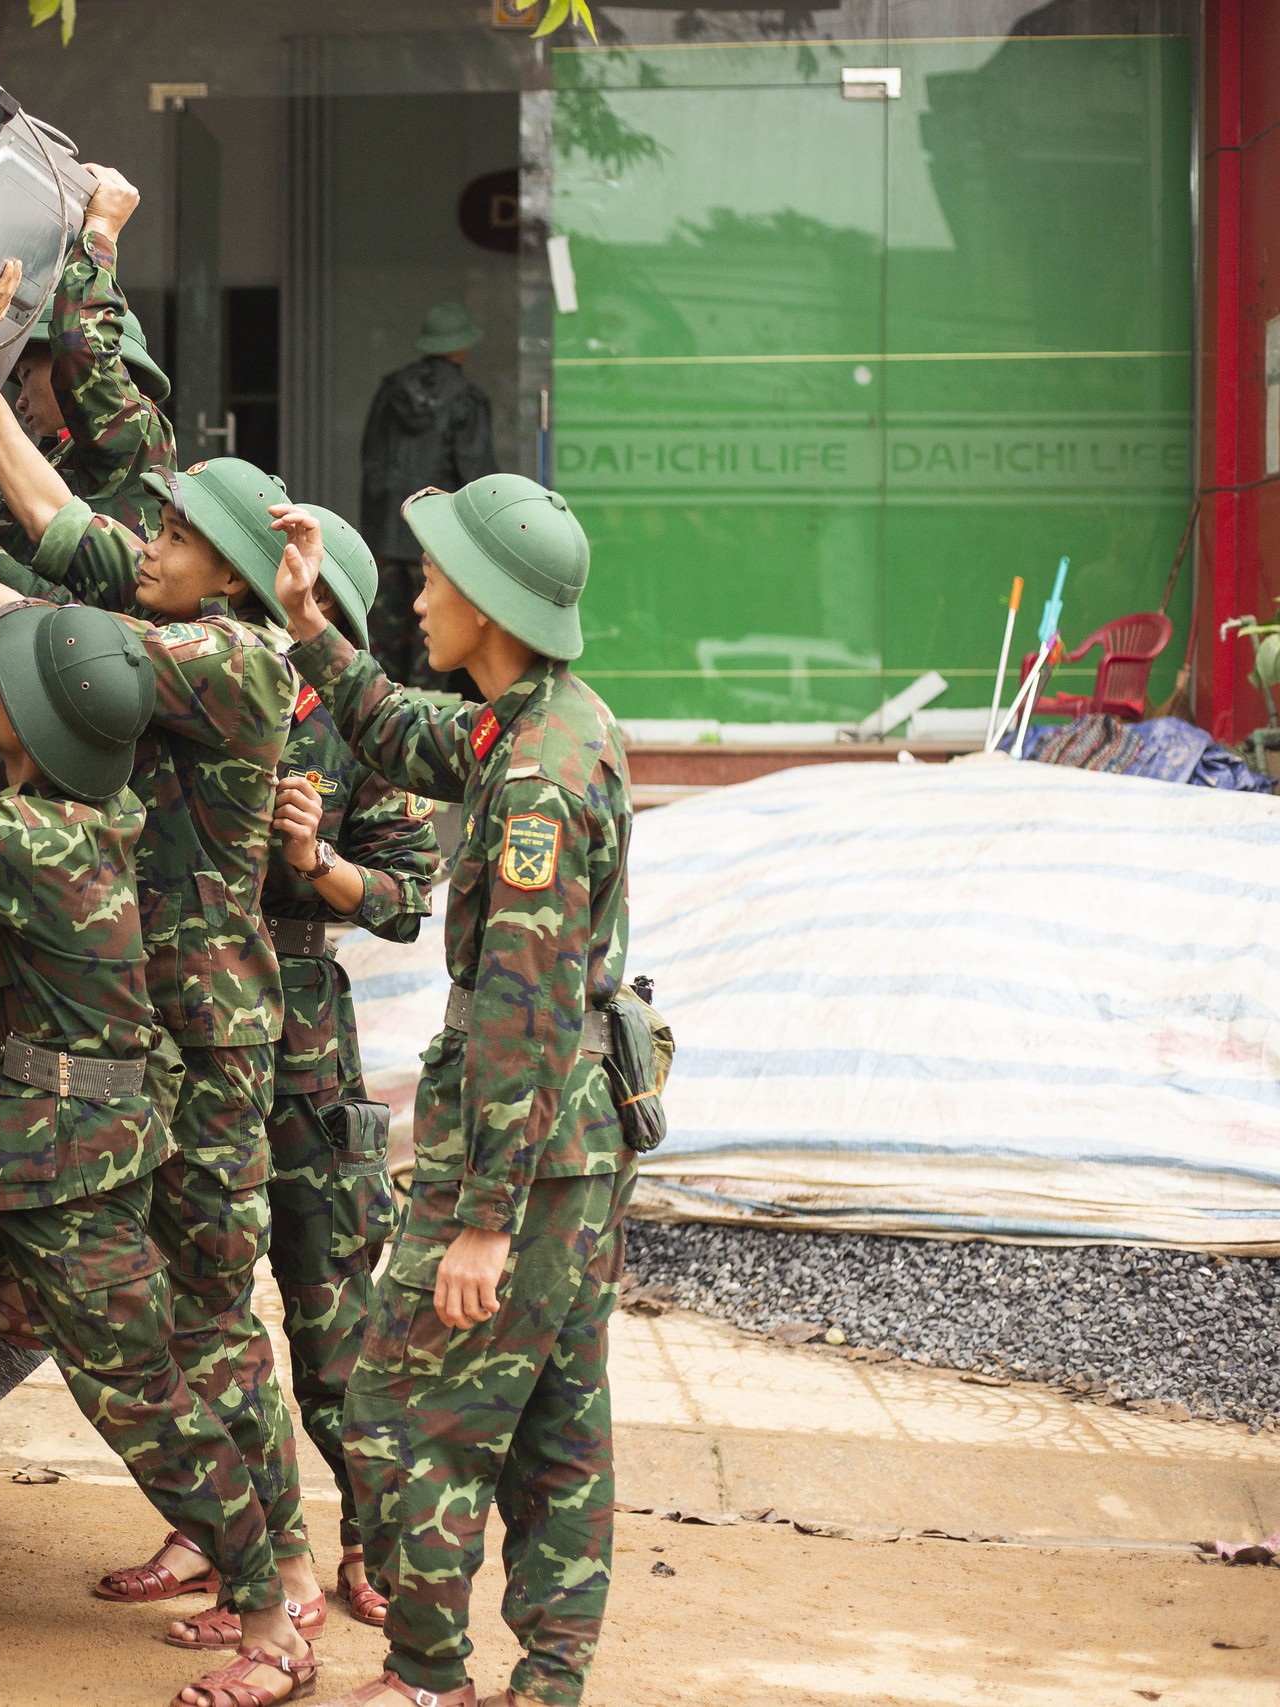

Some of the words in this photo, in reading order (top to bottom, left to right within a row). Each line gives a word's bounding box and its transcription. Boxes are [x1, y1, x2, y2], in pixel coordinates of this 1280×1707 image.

[557, 442, 739, 473] DAI-ICHI
[753, 442, 848, 472] LIFE
[891, 442, 1078, 473] DAI-ICHI
[1091, 441, 1190, 472] LIFE
